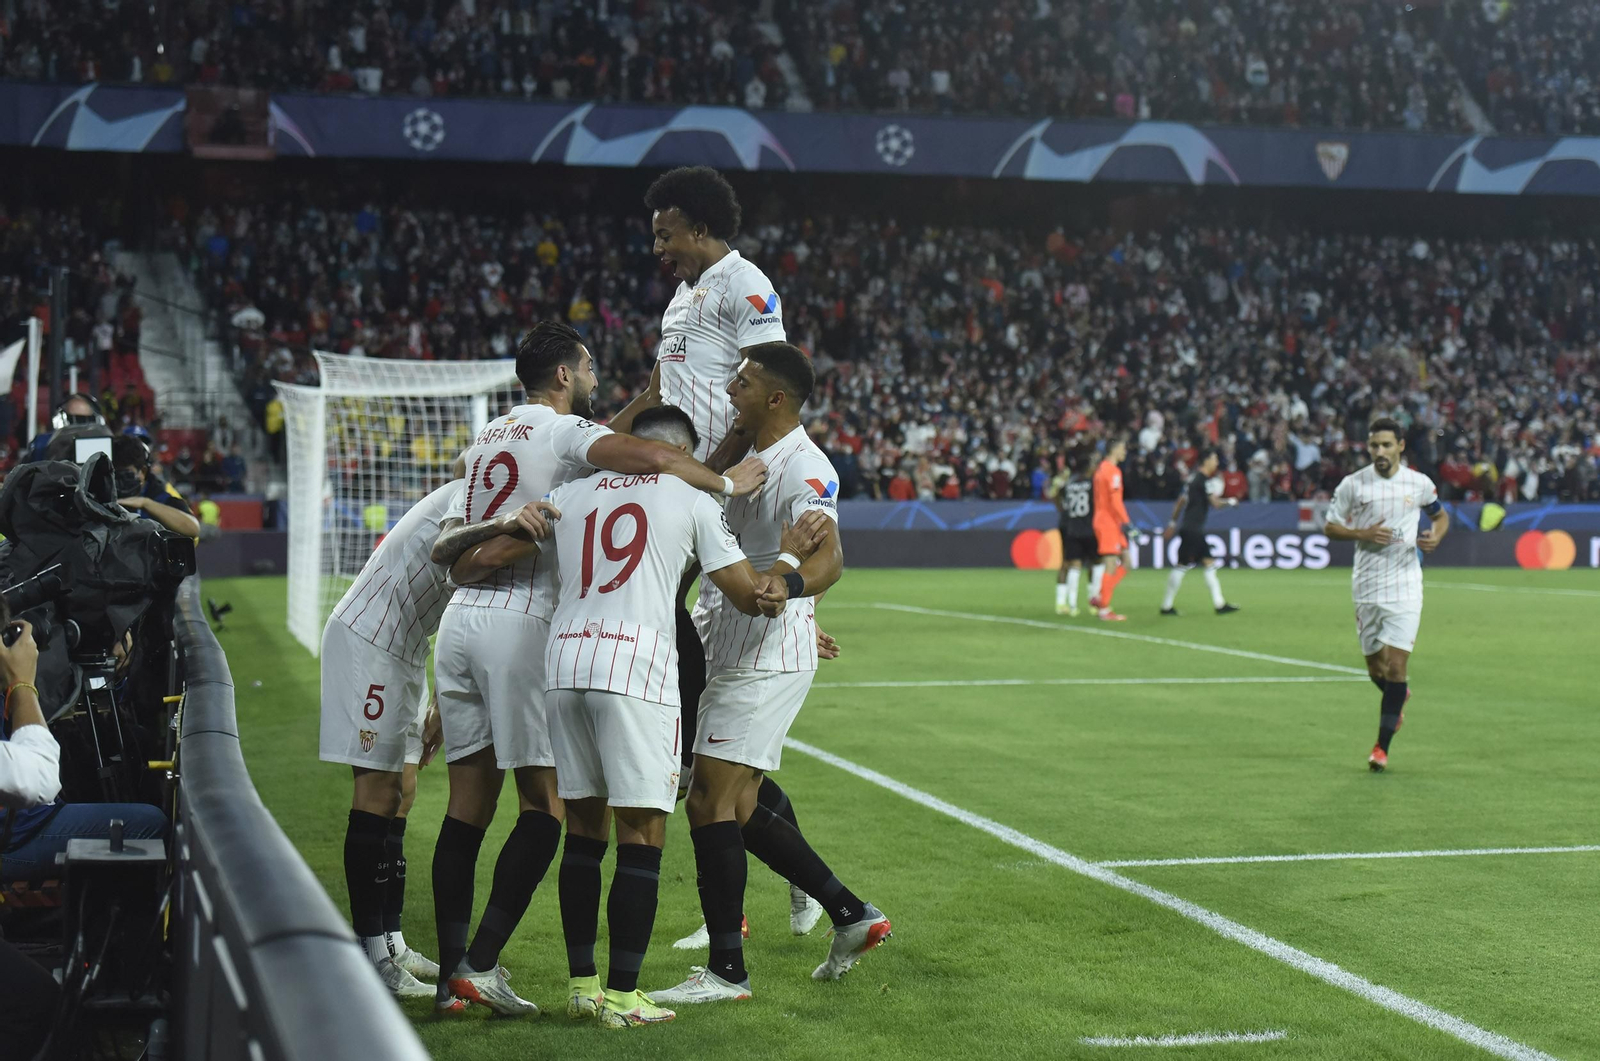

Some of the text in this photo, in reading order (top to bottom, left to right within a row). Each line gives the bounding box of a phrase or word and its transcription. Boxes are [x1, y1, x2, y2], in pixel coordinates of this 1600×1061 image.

[465, 450, 519, 524] 12
[1068, 491, 1090, 518] 28
[579, 502, 648, 600] 19
[557, 631, 635, 643] Manos Unidas
[363, 683, 386, 721] 5
